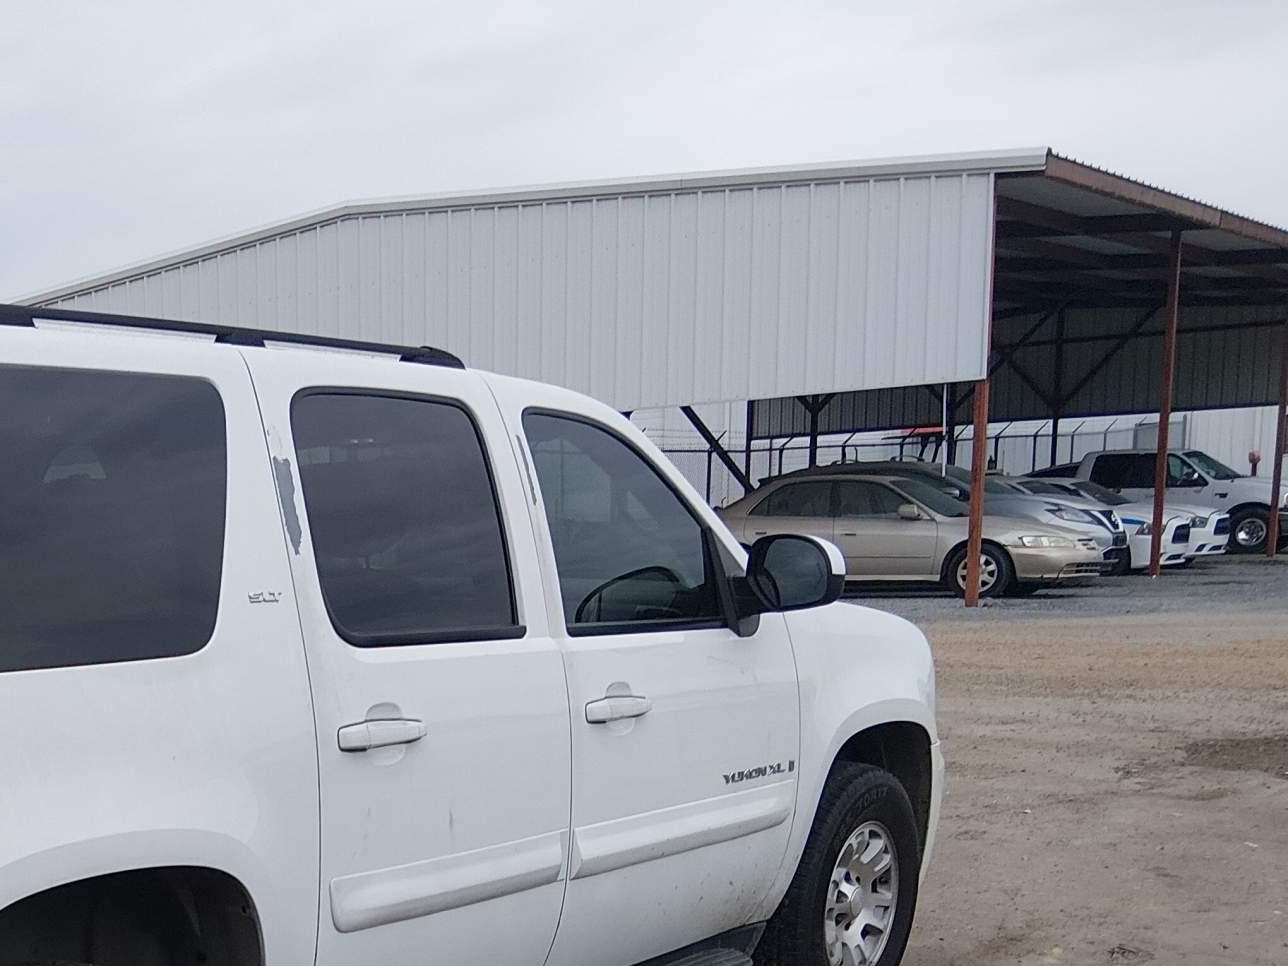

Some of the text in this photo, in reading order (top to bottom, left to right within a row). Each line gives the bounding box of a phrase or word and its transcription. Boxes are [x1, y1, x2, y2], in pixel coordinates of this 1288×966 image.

[247, 591, 282, 604] SLT
[722, 762, 786, 784] YUKON XL
